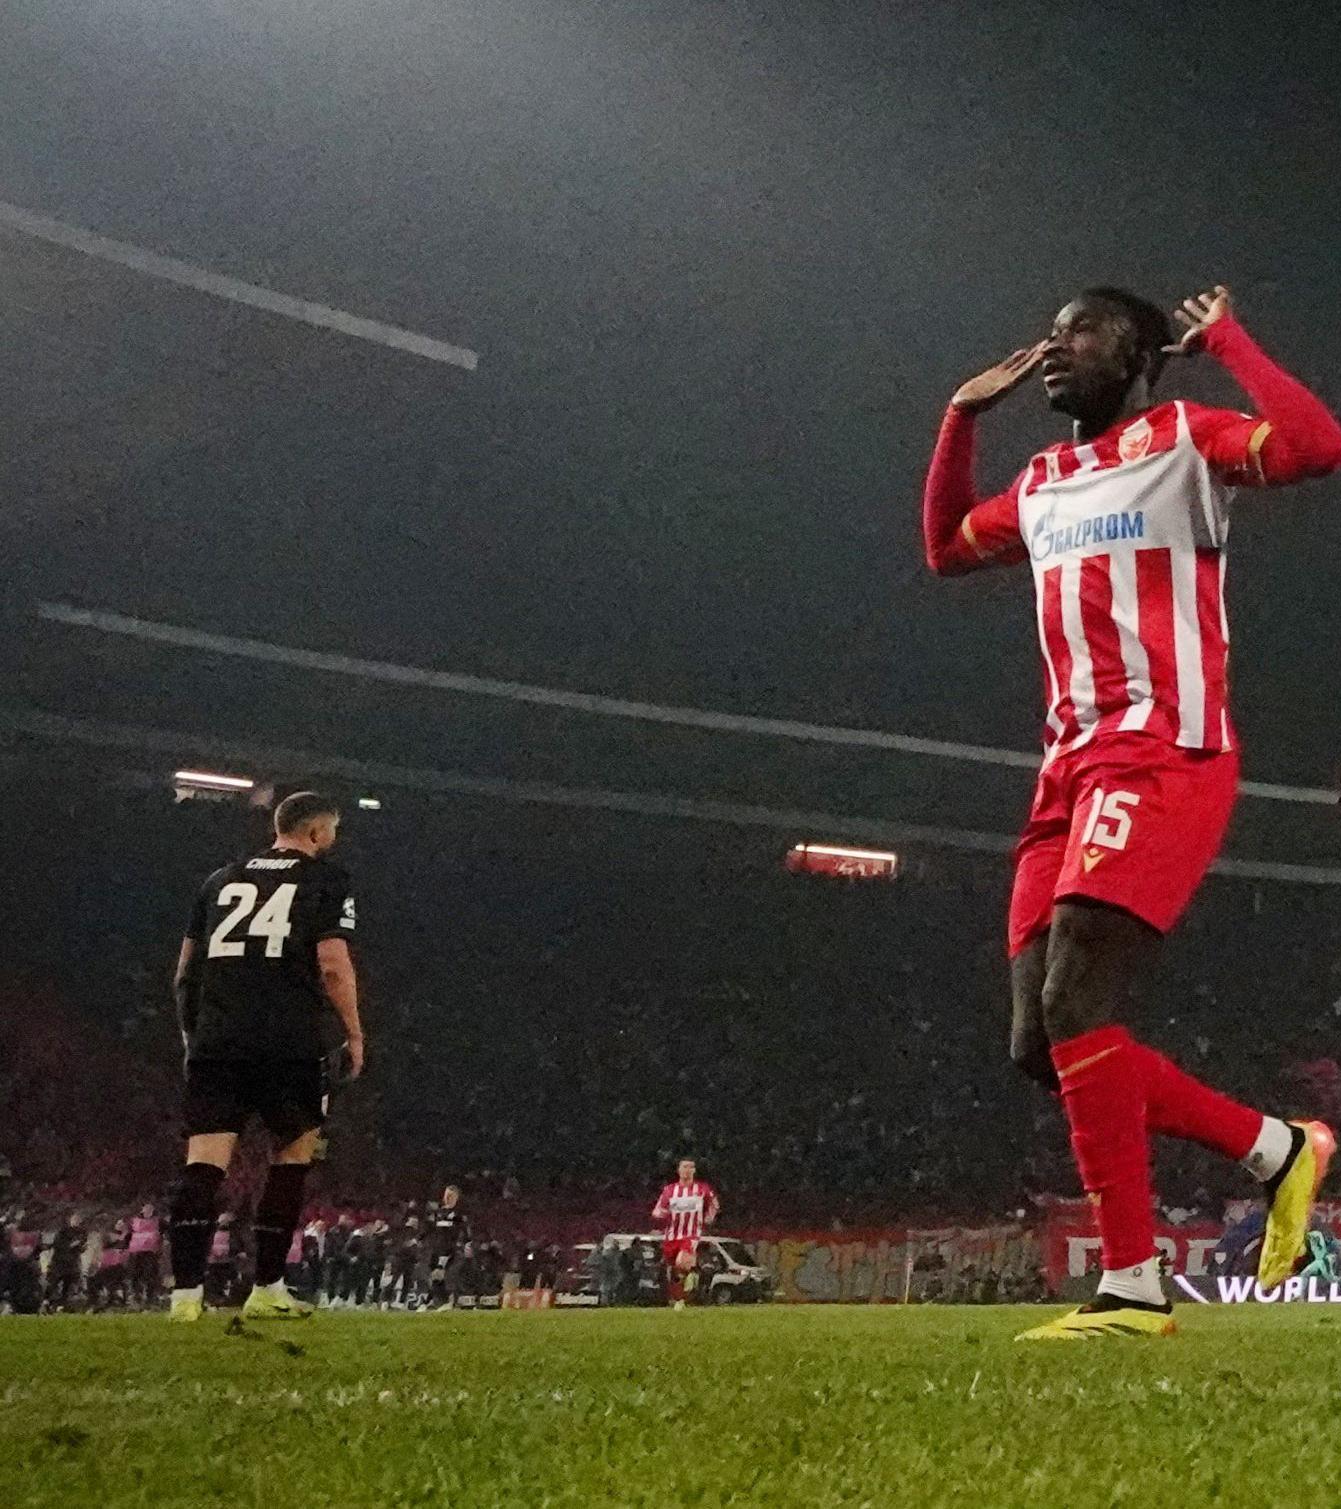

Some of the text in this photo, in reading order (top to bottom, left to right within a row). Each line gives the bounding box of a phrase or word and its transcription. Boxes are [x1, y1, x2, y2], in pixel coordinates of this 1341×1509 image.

[1054, 511, 1144, 554] GAZPROM
[1081, 788, 1141, 850] 15
[207, 882, 298, 959] 24
